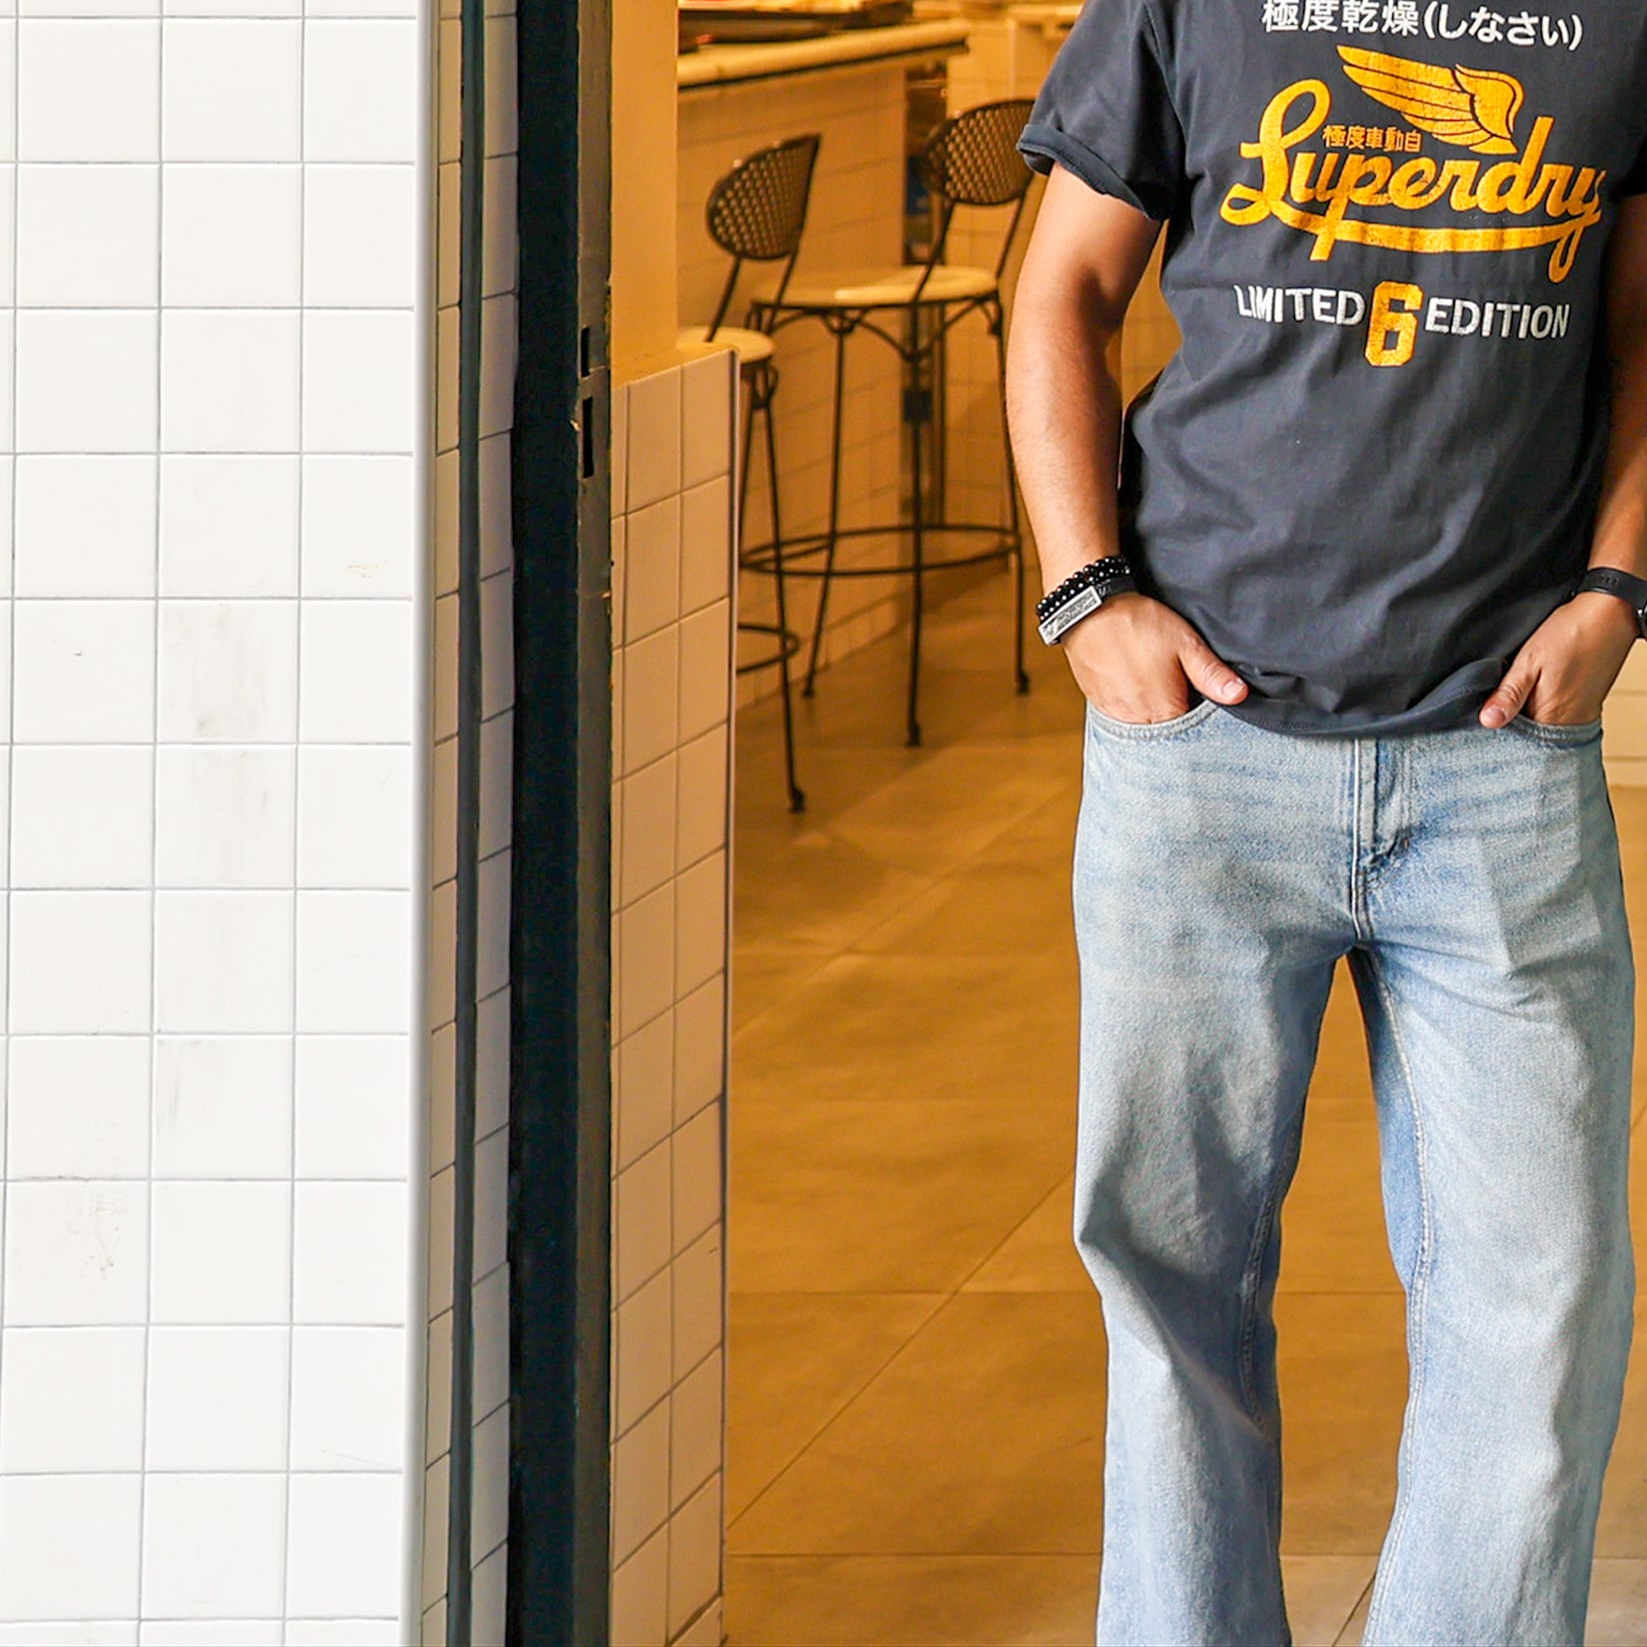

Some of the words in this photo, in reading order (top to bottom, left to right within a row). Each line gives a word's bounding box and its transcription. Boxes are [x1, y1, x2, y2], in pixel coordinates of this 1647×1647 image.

[1219, 78, 1606, 284] Superdry
[1234, 284, 1365, 326] LIMITED
[1364, 280, 1424, 367] 6
[1424, 297, 1570, 339] EDITION
